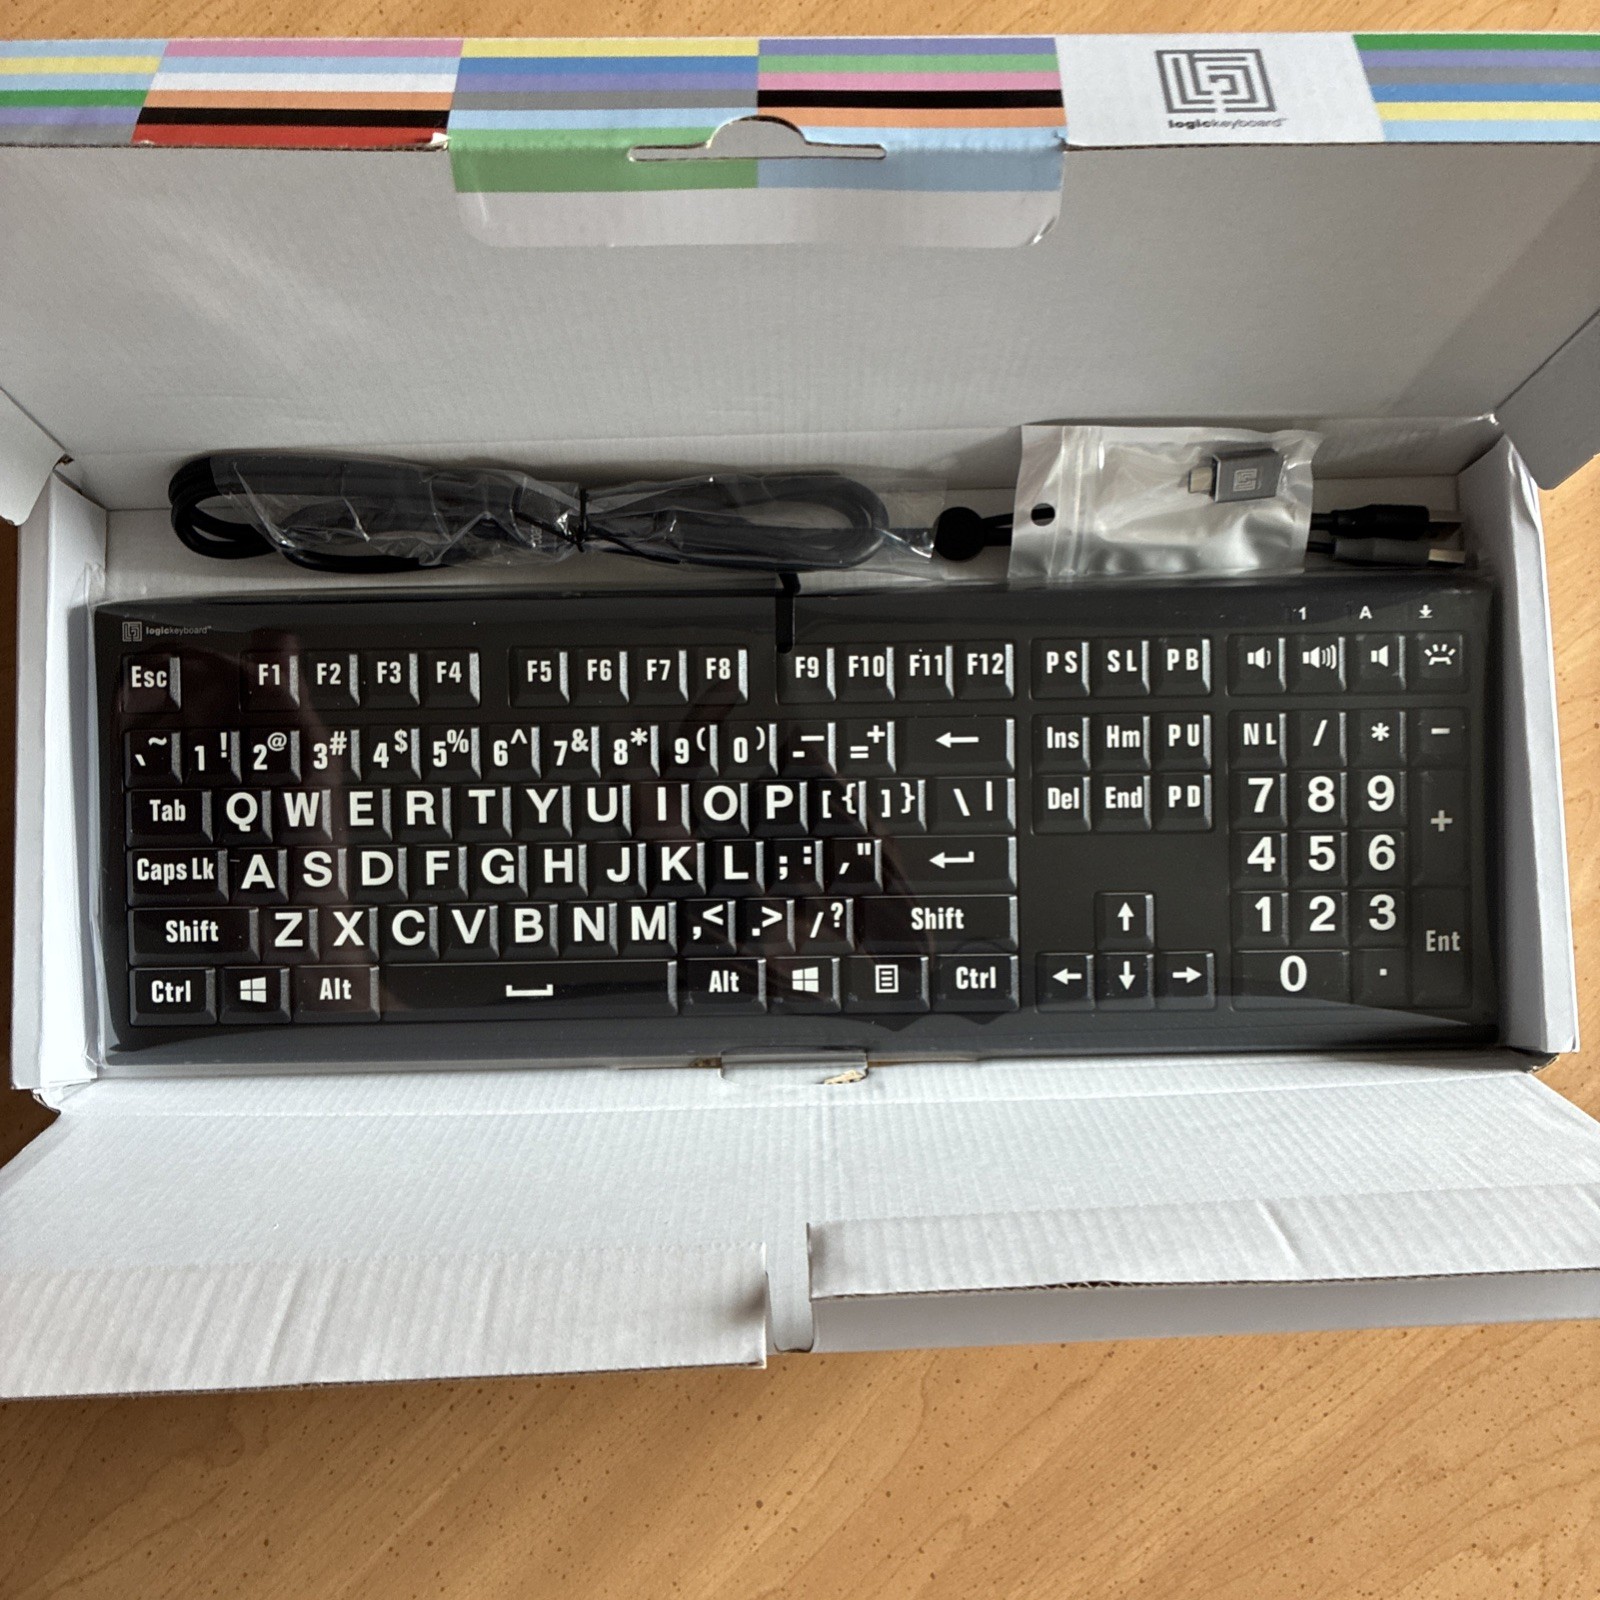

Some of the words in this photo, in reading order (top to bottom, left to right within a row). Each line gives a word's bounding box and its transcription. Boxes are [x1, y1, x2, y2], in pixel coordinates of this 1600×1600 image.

[1298, 606, 1306, 620] 1
[1359, 605, 1373, 620] A
[131, 665, 167, 688] Esc
[258, 663, 281, 686] F1
[316, 662, 342, 685] F2
[377, 661, 402, 684] F3
[436, 661, 462, 684] F4
[527, 660, 552, 683] F5
[587, 659, 612, 681] F6
[646, 659, 671, 681] F7
[706, 657, 731, 680] F8
[795, 656, 819, 679] F9
[848, 655, 885, 678] F10
[909, 654, 943, 677] F11
[967, 652, 1004, 676] F12
[1046, 726, 1080, 749] Ins
[1106, 725, 1141, 749] Hm
[149, 799, 186, 822] Tab
[283, 792, 320, 827] W
[349, 791, 374, 826] E
[406, 790, 436, 826] R
[468, 789, 496, 824] T
[525, 788, 559, 823] Y
[587, 787, 618, 823] U
[657, 786, 667, 821] I
[703, 785, 738, 821] O
[766, 784, 794, 820] P
[1047, 787, 1080, 810] Del
[1105, 785, 1143, 809] End
[1248, 777, 1274, 813] 7
[1307, 775, 1335, 813] 8
[1367, 774, 1395, 812] 9
[226, 791, 258, 832] Q
[302, 850, 333, 888] S
[361, 850, 394, 886] D
[425, 850, 450, 886] F
[481, 848, 515, 885] G
[544, 848, 573, 884] H
[606, 847, 630, 883] J
[661, 846, 693, 881] K
[724, 845, 749, 880] L
[1247, 836, 1276, 872] 4
[1308, 835, 1336, 872] 5
[1368, 834, 1396, 871] 6
[137, 858, 188, 886] Caps
[192, 857, 215, 880] Lk
[240, 854, 276, 890] A
[274, 912, 304, 947] Z
[333, 911, 364, 947] X
[391, 909, 426, 946] C
[451, 908, 486, 944] V
[514, 908, 544, 943] B
[573, 906, 605, 942] N
[631, 905, 666, 941] M
[911, 906, 965, 931] Shift
[1254, 896, 1271, 932] 1
[1309, 895, 1336, 932] 2
[1368, 894, 1396, 931] 3
[165, 919, 219, 943] Shift
[1426, 930, 1460, 952] Ent
[319, 977, 352, 1000] Alt
[708, 970, 740, 993] Alt
[955, 966, 996, 990] Ctrl
[1280, 955, 1307, 992] 0
[151, 980, 191, 1003] Ctrl
